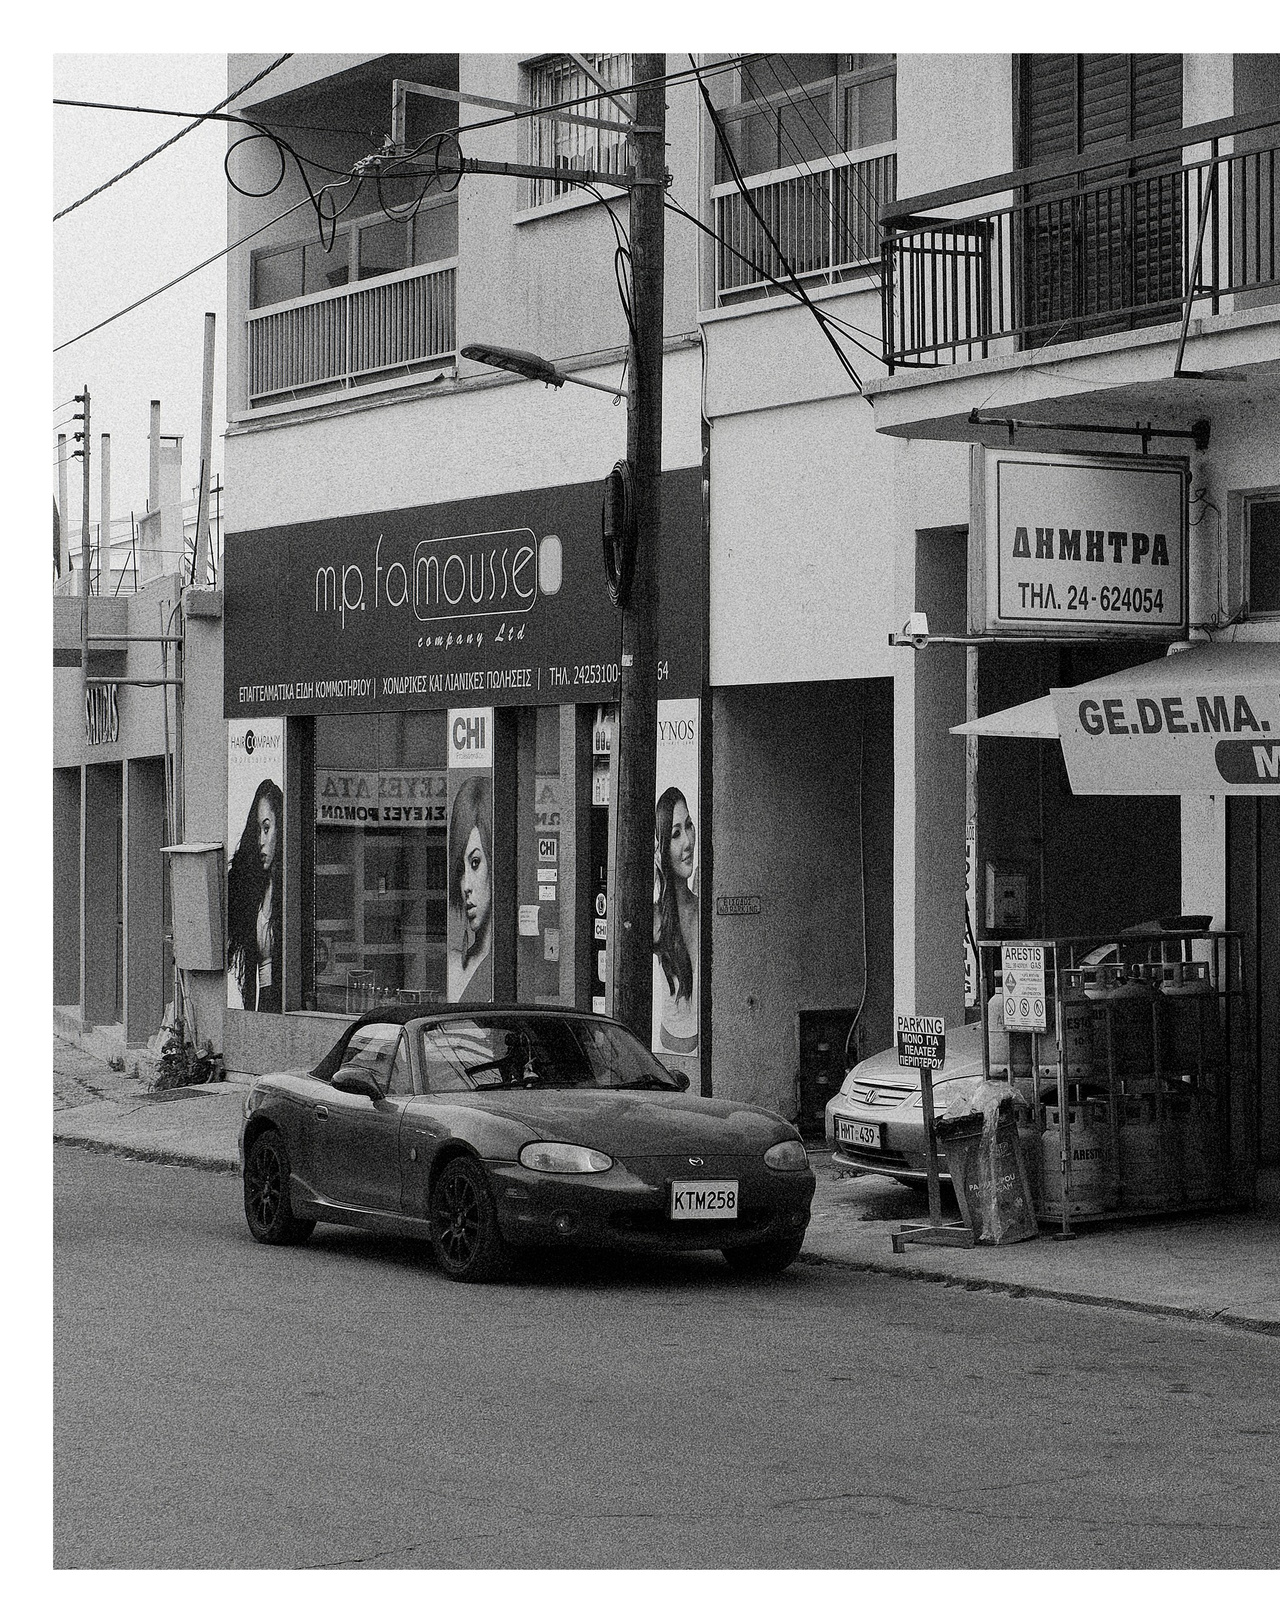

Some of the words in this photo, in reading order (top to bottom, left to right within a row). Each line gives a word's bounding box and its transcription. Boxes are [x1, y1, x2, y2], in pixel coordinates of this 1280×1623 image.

[1012, 526, 1170, 566] ΔΗΜΗΤΡΑ
[1018, 582, 1062, 610] ΤΗΛ.
[417, 629, 484, 650] company
[494, 622, 526, 643] Ltd
[239, 683, 295, 703] ΕΠΑΓΓΕΛΜΑΤΙΚΑ
[295, 681, 314, 700] ΕΙΔΗ
[315, 678, 372, 699] ΚΟΜΜΩΤΗΡΙΟΥ
[382, 674, 427, 694] ΧΟΝΔΡΙΚΕΣ
[429, 672, 443, 692] ΚΑΙ
[444, 671, 485, 691] ΛΙΑΝΙΚΕΣ
[486, 668, 532, 689] ΠΩΛΗΣΕΙΣ
[549, 666, 570, 686] ΤΗΛ.
[1078, 695, 1272, 735] GE.DE.MA.
[453, 716, 486, 750] CHI
[539, 840, 556, 856] CHI
[1004, 947, 1042, 961] ARESTIS
[1030, 962, 1042, 970] GAS
[897, 1016, 943, 1034] PARKING
[902, 1032, 923, 1045] ΜΟΝΟ
[926, 1035, 939, 1046] ΓΙΑ
[904, 1044, 937, 1057] ΠΕΛΑΤΕΣ
[899, 1054, 943, 1069] ΠΕΡΙΠΤΕΡΟΥ
[839, 1123, 855, 1142] HMT
[858, 1126, 875, 1145] 439
[674, 1190, 736, 1211] KTM258
